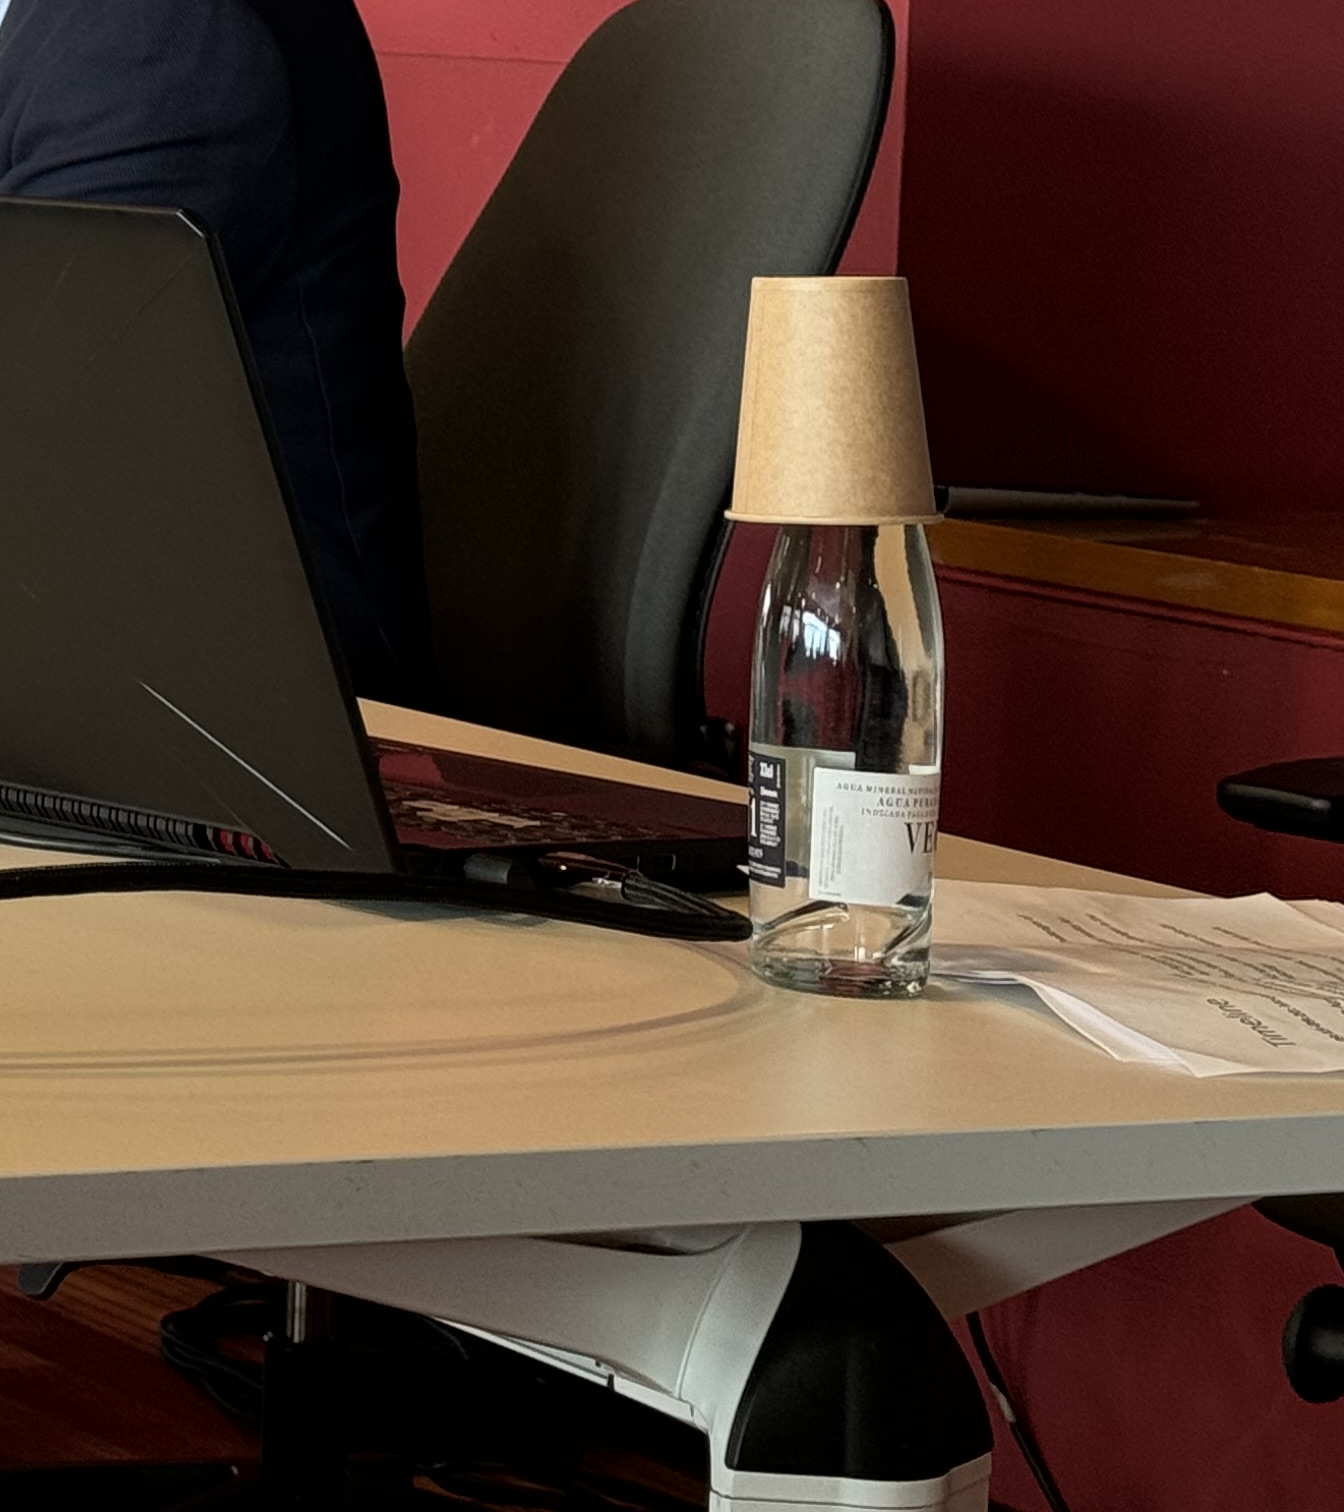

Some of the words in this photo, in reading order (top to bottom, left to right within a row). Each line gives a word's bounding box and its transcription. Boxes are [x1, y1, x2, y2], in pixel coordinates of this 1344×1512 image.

[836, 782, 864, 793] AGUA
[877, 797, 910, 808] AGUA
[1206, 998, 1296, 1048] Timeline
